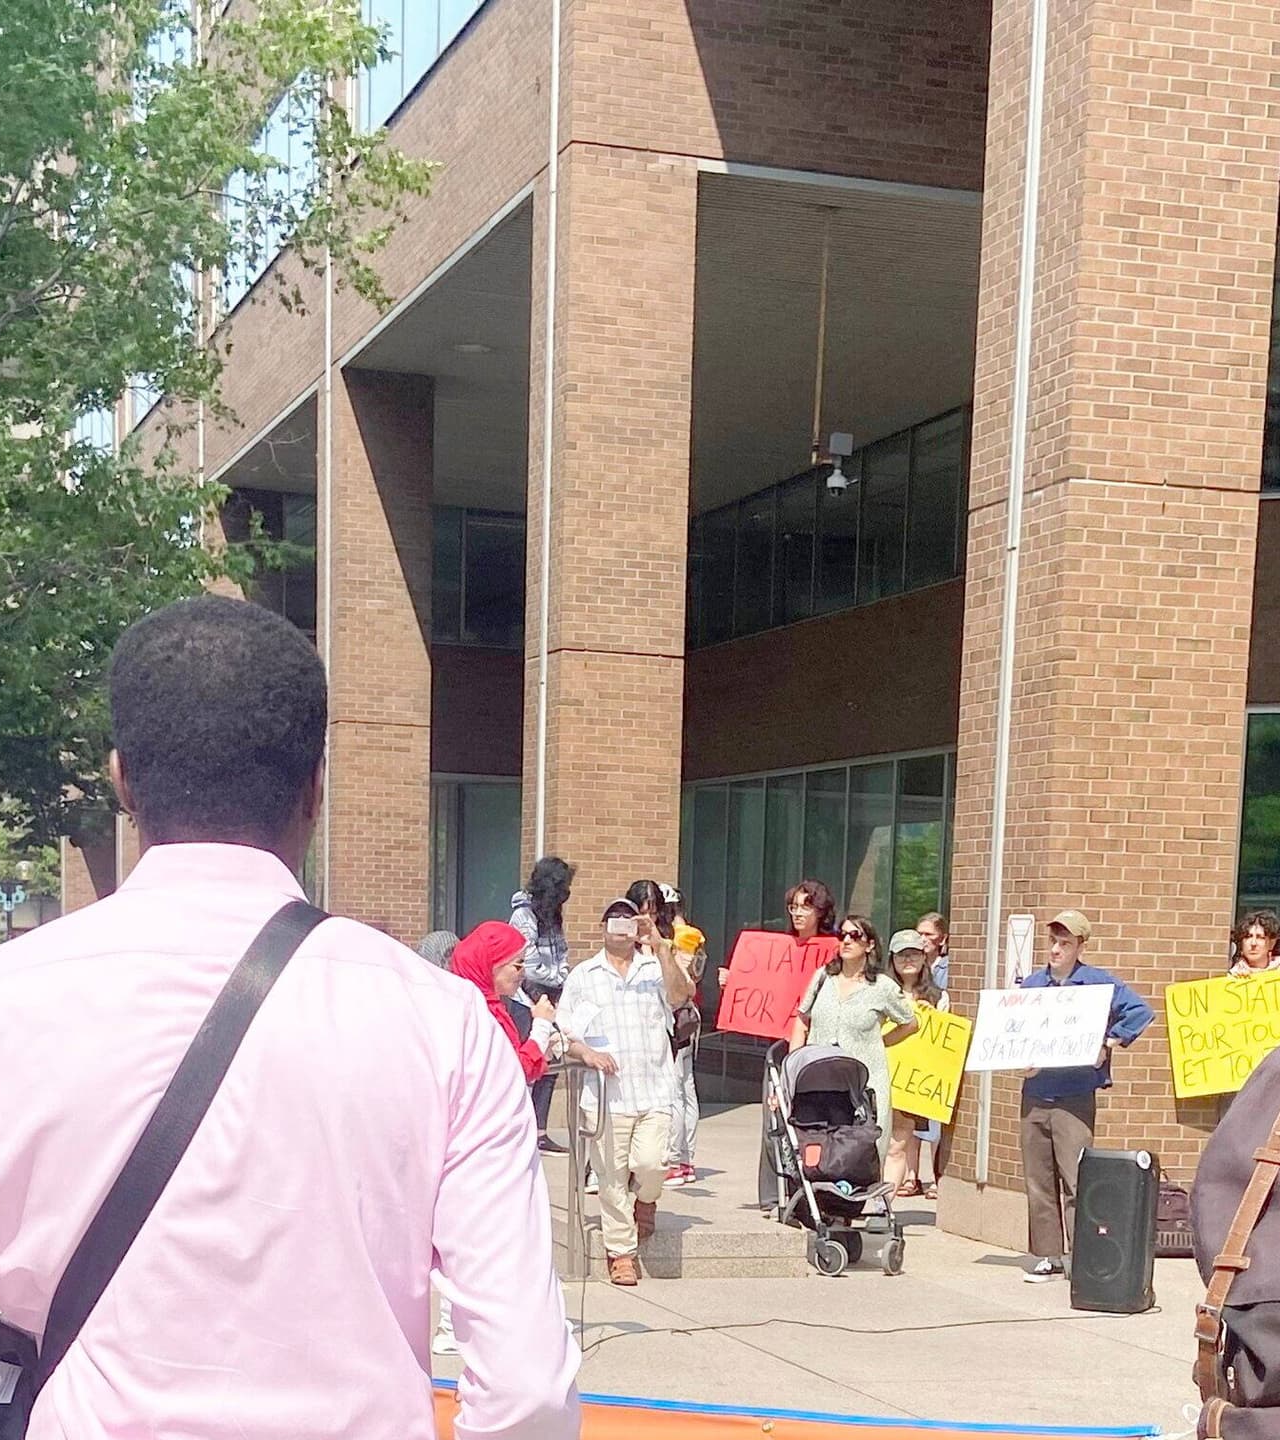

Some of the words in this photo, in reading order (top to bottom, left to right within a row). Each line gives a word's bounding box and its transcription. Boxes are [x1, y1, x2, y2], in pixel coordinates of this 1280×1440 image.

[740, 938, 829, 974] STATU
[729, 987, 775, 1024] FOR
[1172, 985, 1209, 1018] UN
[1178, 1023, 1232, 1054] POUR
[1182, 1057, 1212, 1087] ET
